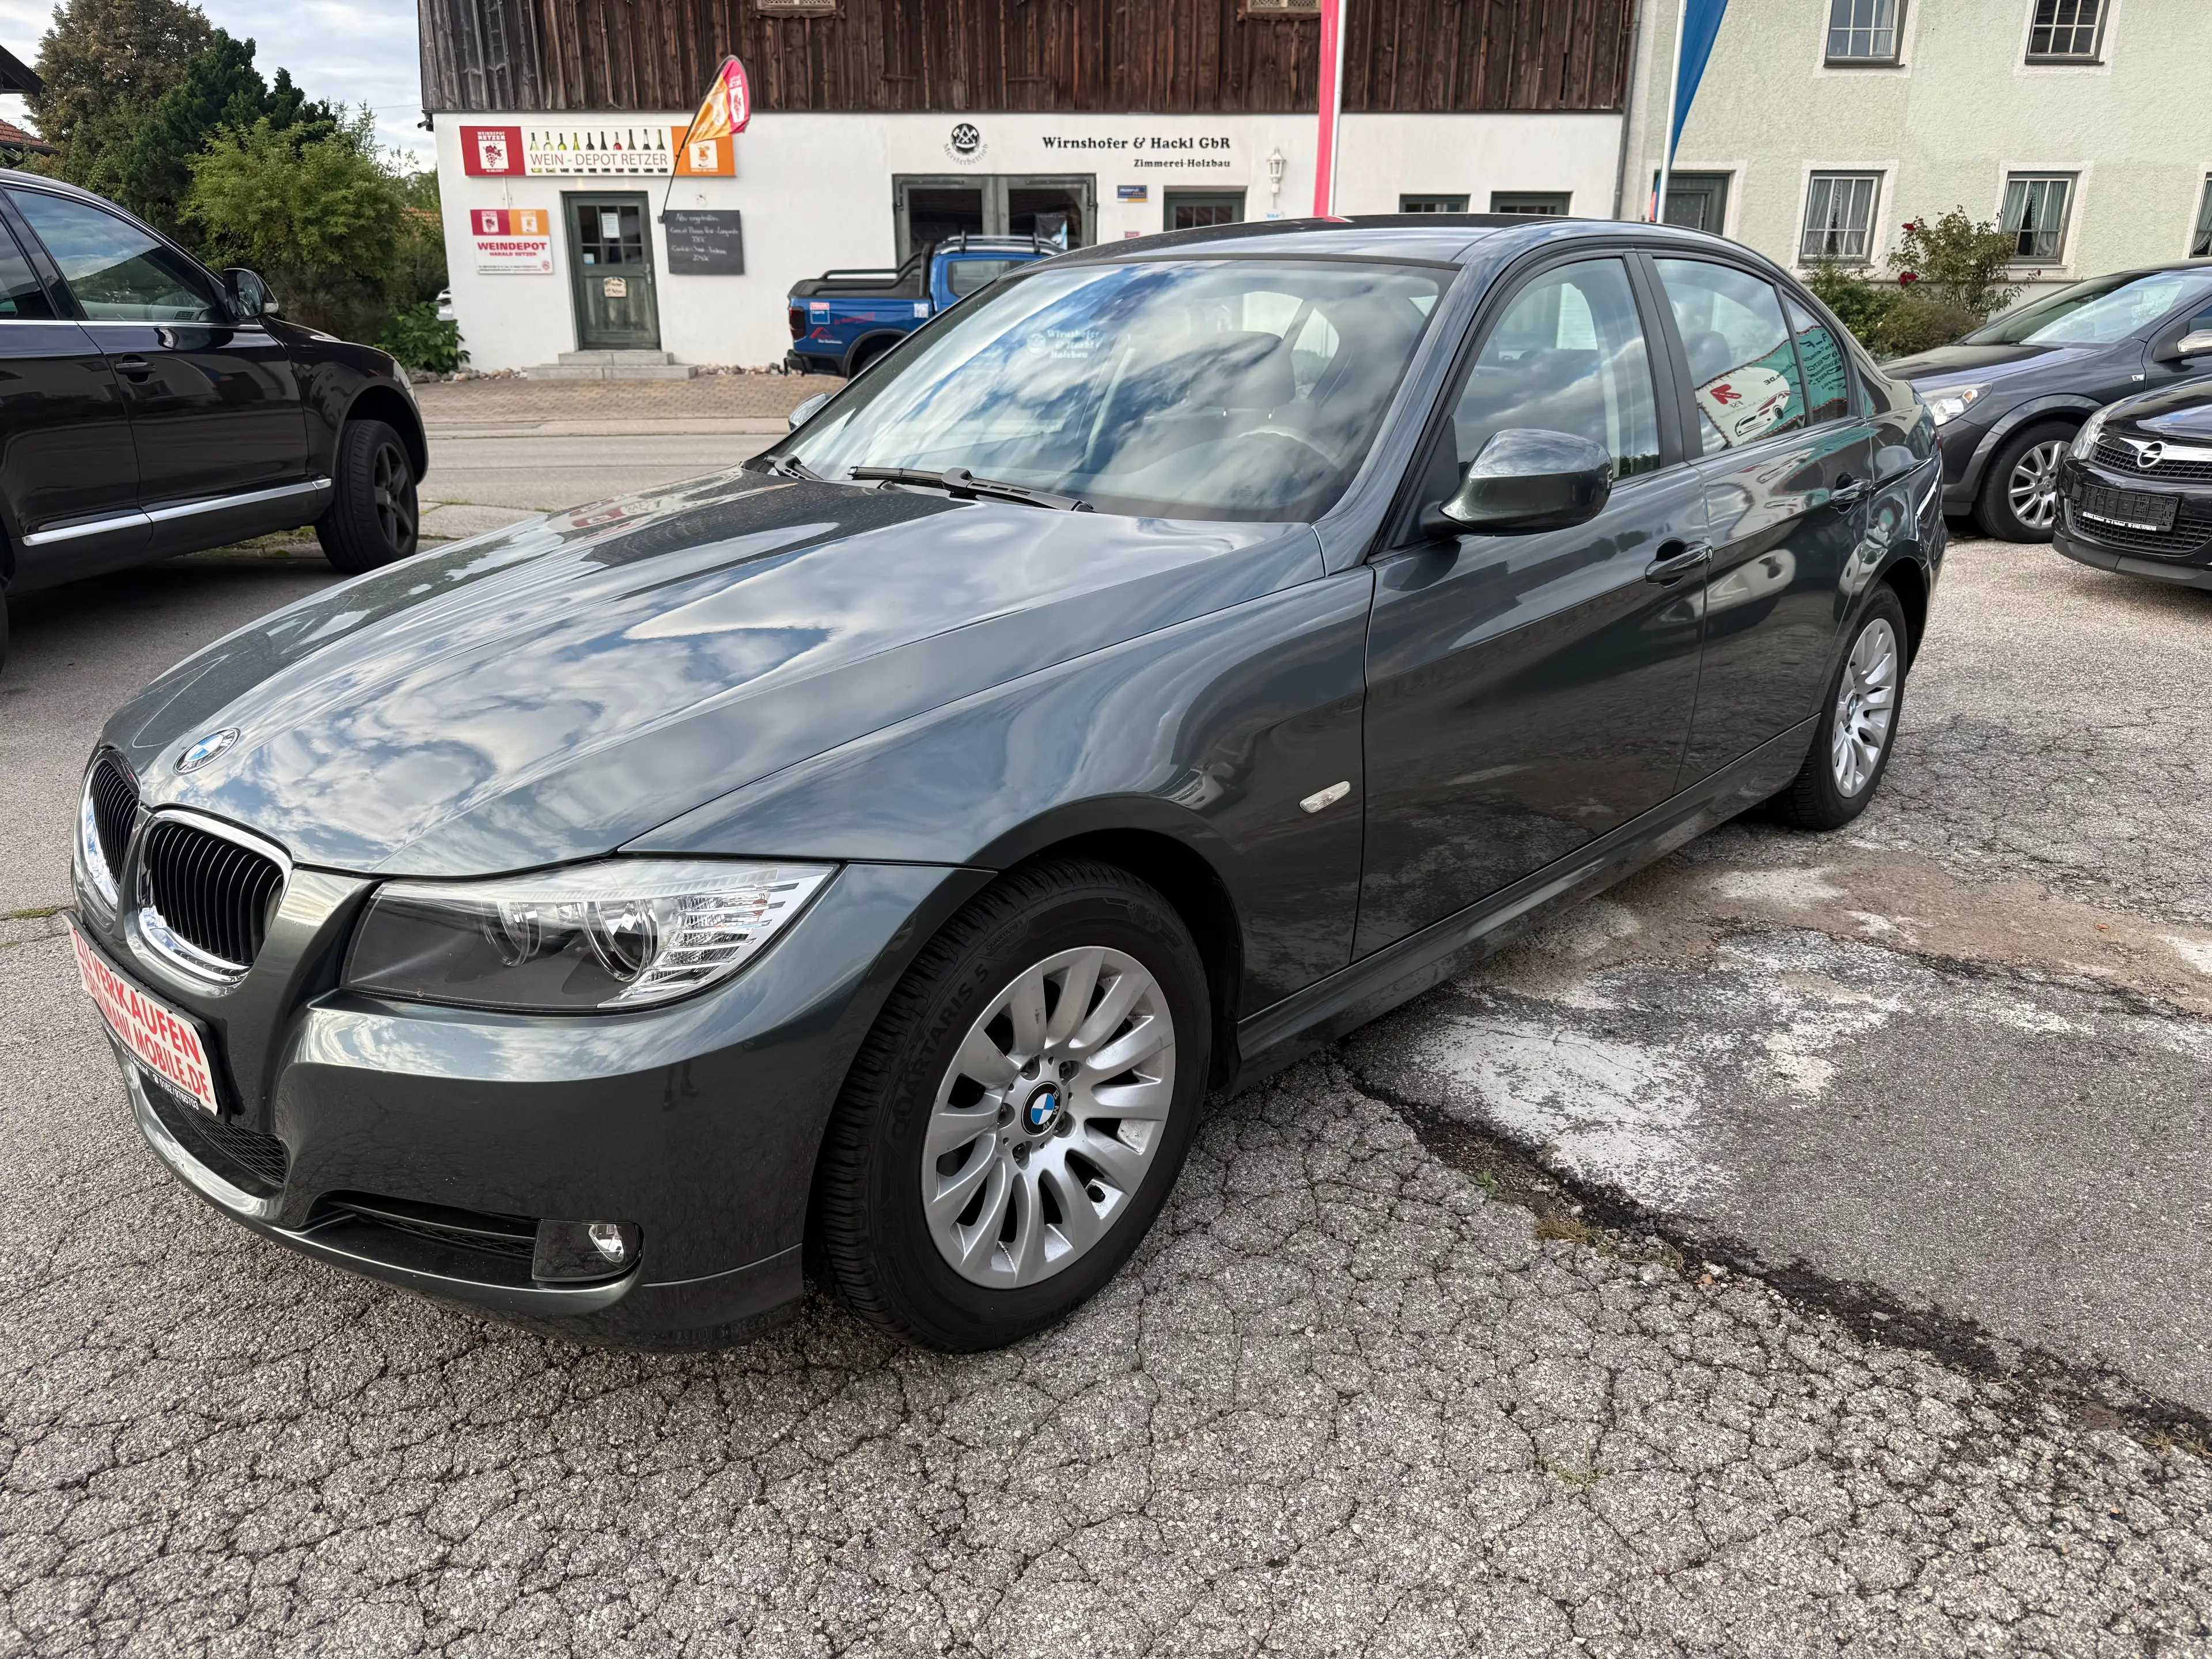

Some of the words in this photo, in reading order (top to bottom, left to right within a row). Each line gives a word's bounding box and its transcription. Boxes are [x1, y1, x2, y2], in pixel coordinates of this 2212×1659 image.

[1042, 137, 1128, 149] Wirnshofer
[1133, 137, 1146, 149] &
[1150, 137, 1194, 149] Hackl
[1199, 137, 1231, 149] GbR
[529, 153, 564, 166] WEIN
[575, 153, 618, 166] DEPOT
[621, 153, 668, 166] RETZER
[1132, 158, 1231, 168] Zimmerei-Holzbau
[477, 242, 547, 251] WEINDEPOT
[71, 926, 92, 971] ZU
[89, 950, 202, 1066] VERKAUFEN
[133, 1022, 211, 1104] MOBILE.DE
[892, 982, 974, 1140] QUARTARIS
[974, 963, 989, 983] 5
[1042, 1089, 1060, 1131] BMW
